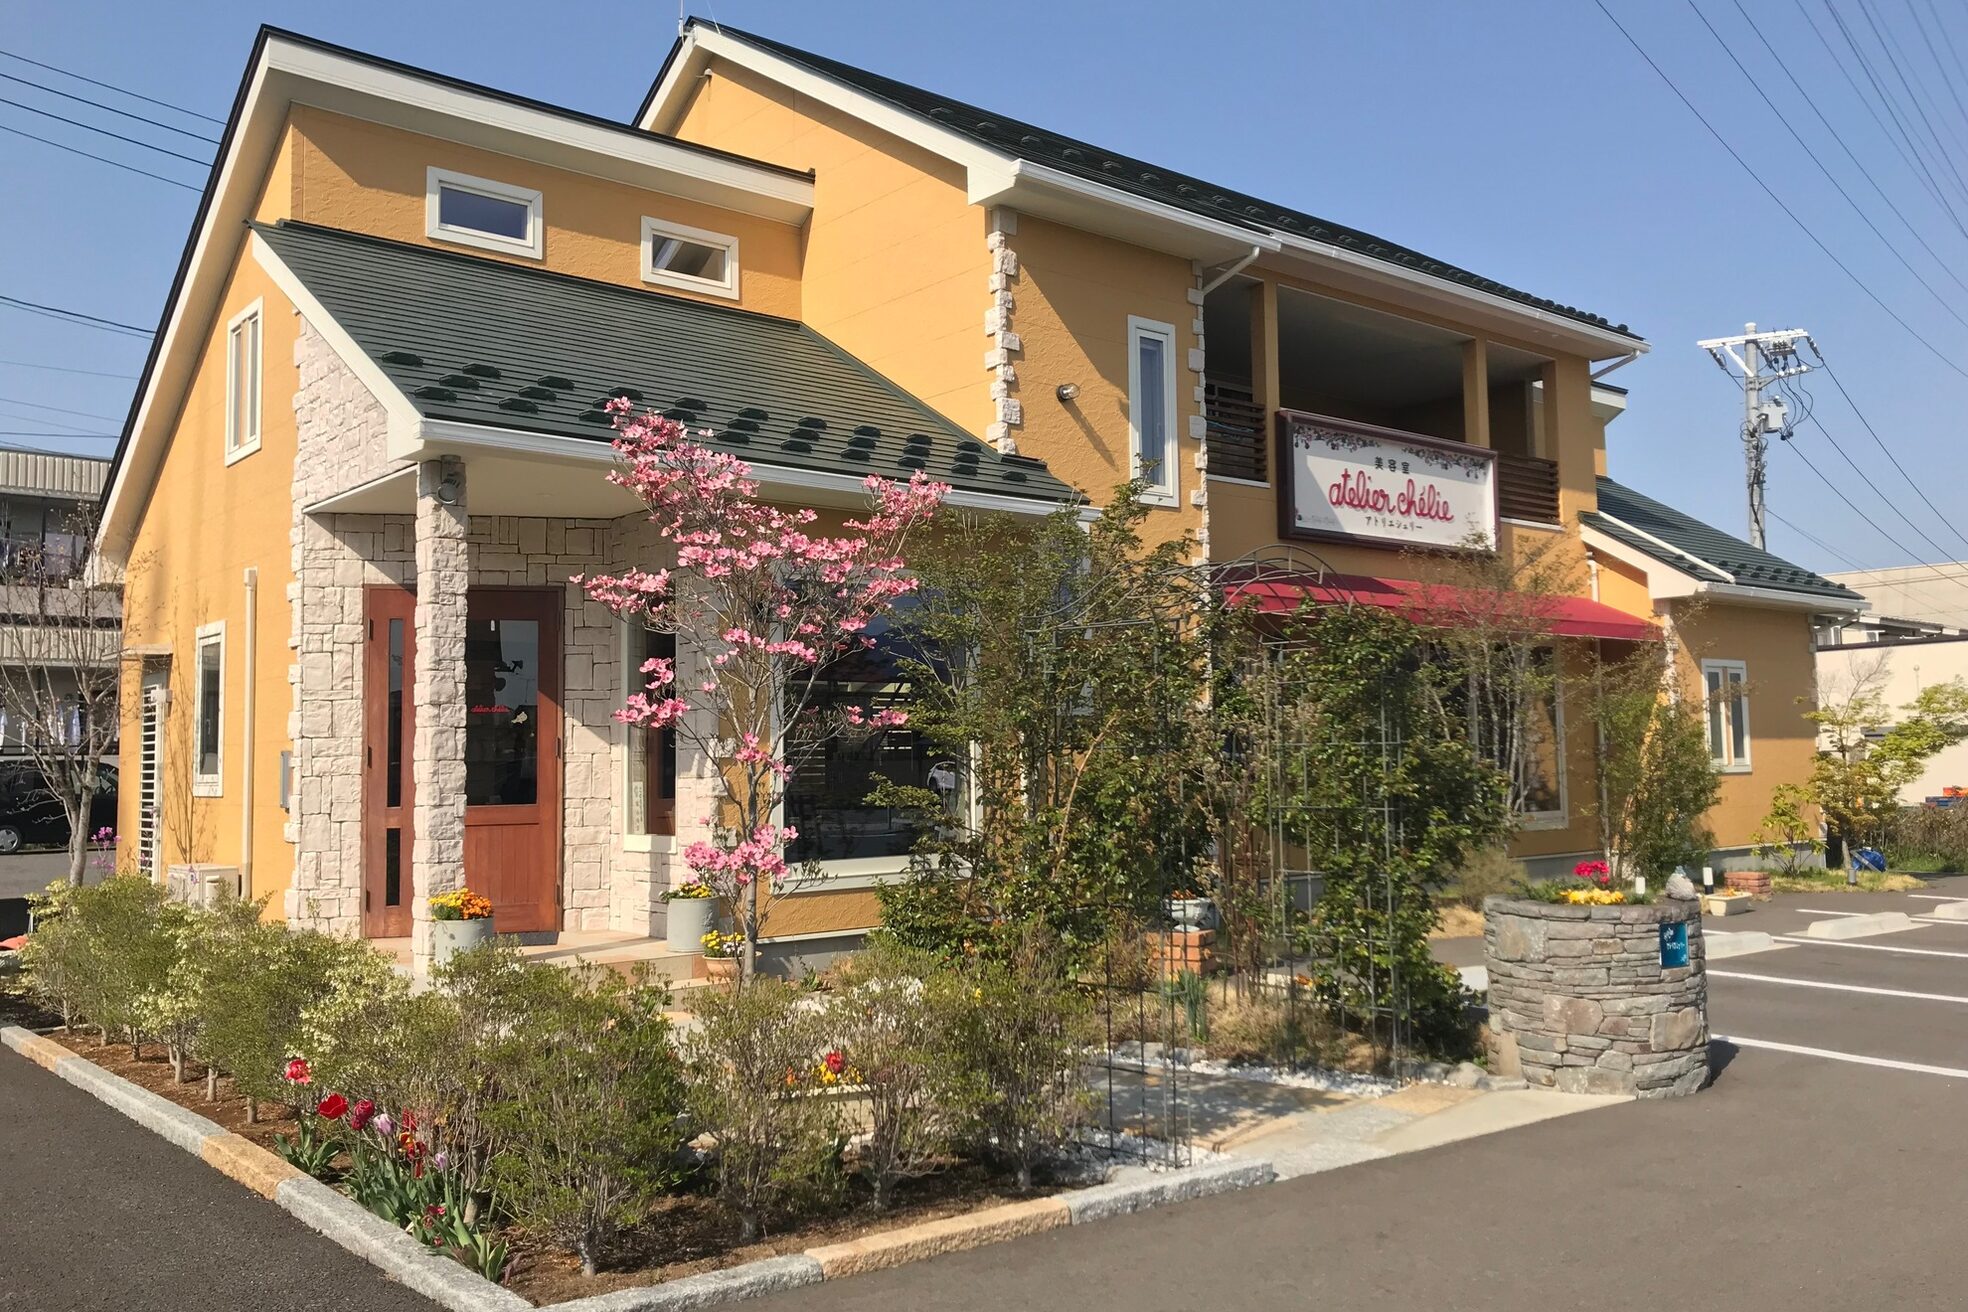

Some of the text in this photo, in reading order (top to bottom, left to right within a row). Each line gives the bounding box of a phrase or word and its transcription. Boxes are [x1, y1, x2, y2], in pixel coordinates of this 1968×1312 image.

[1374, 456, 1410, 475] 美容室
[1328, 468, 1454, 522] atelier chélie
[1365, 516, 1423, 531] アトリエシェリー
